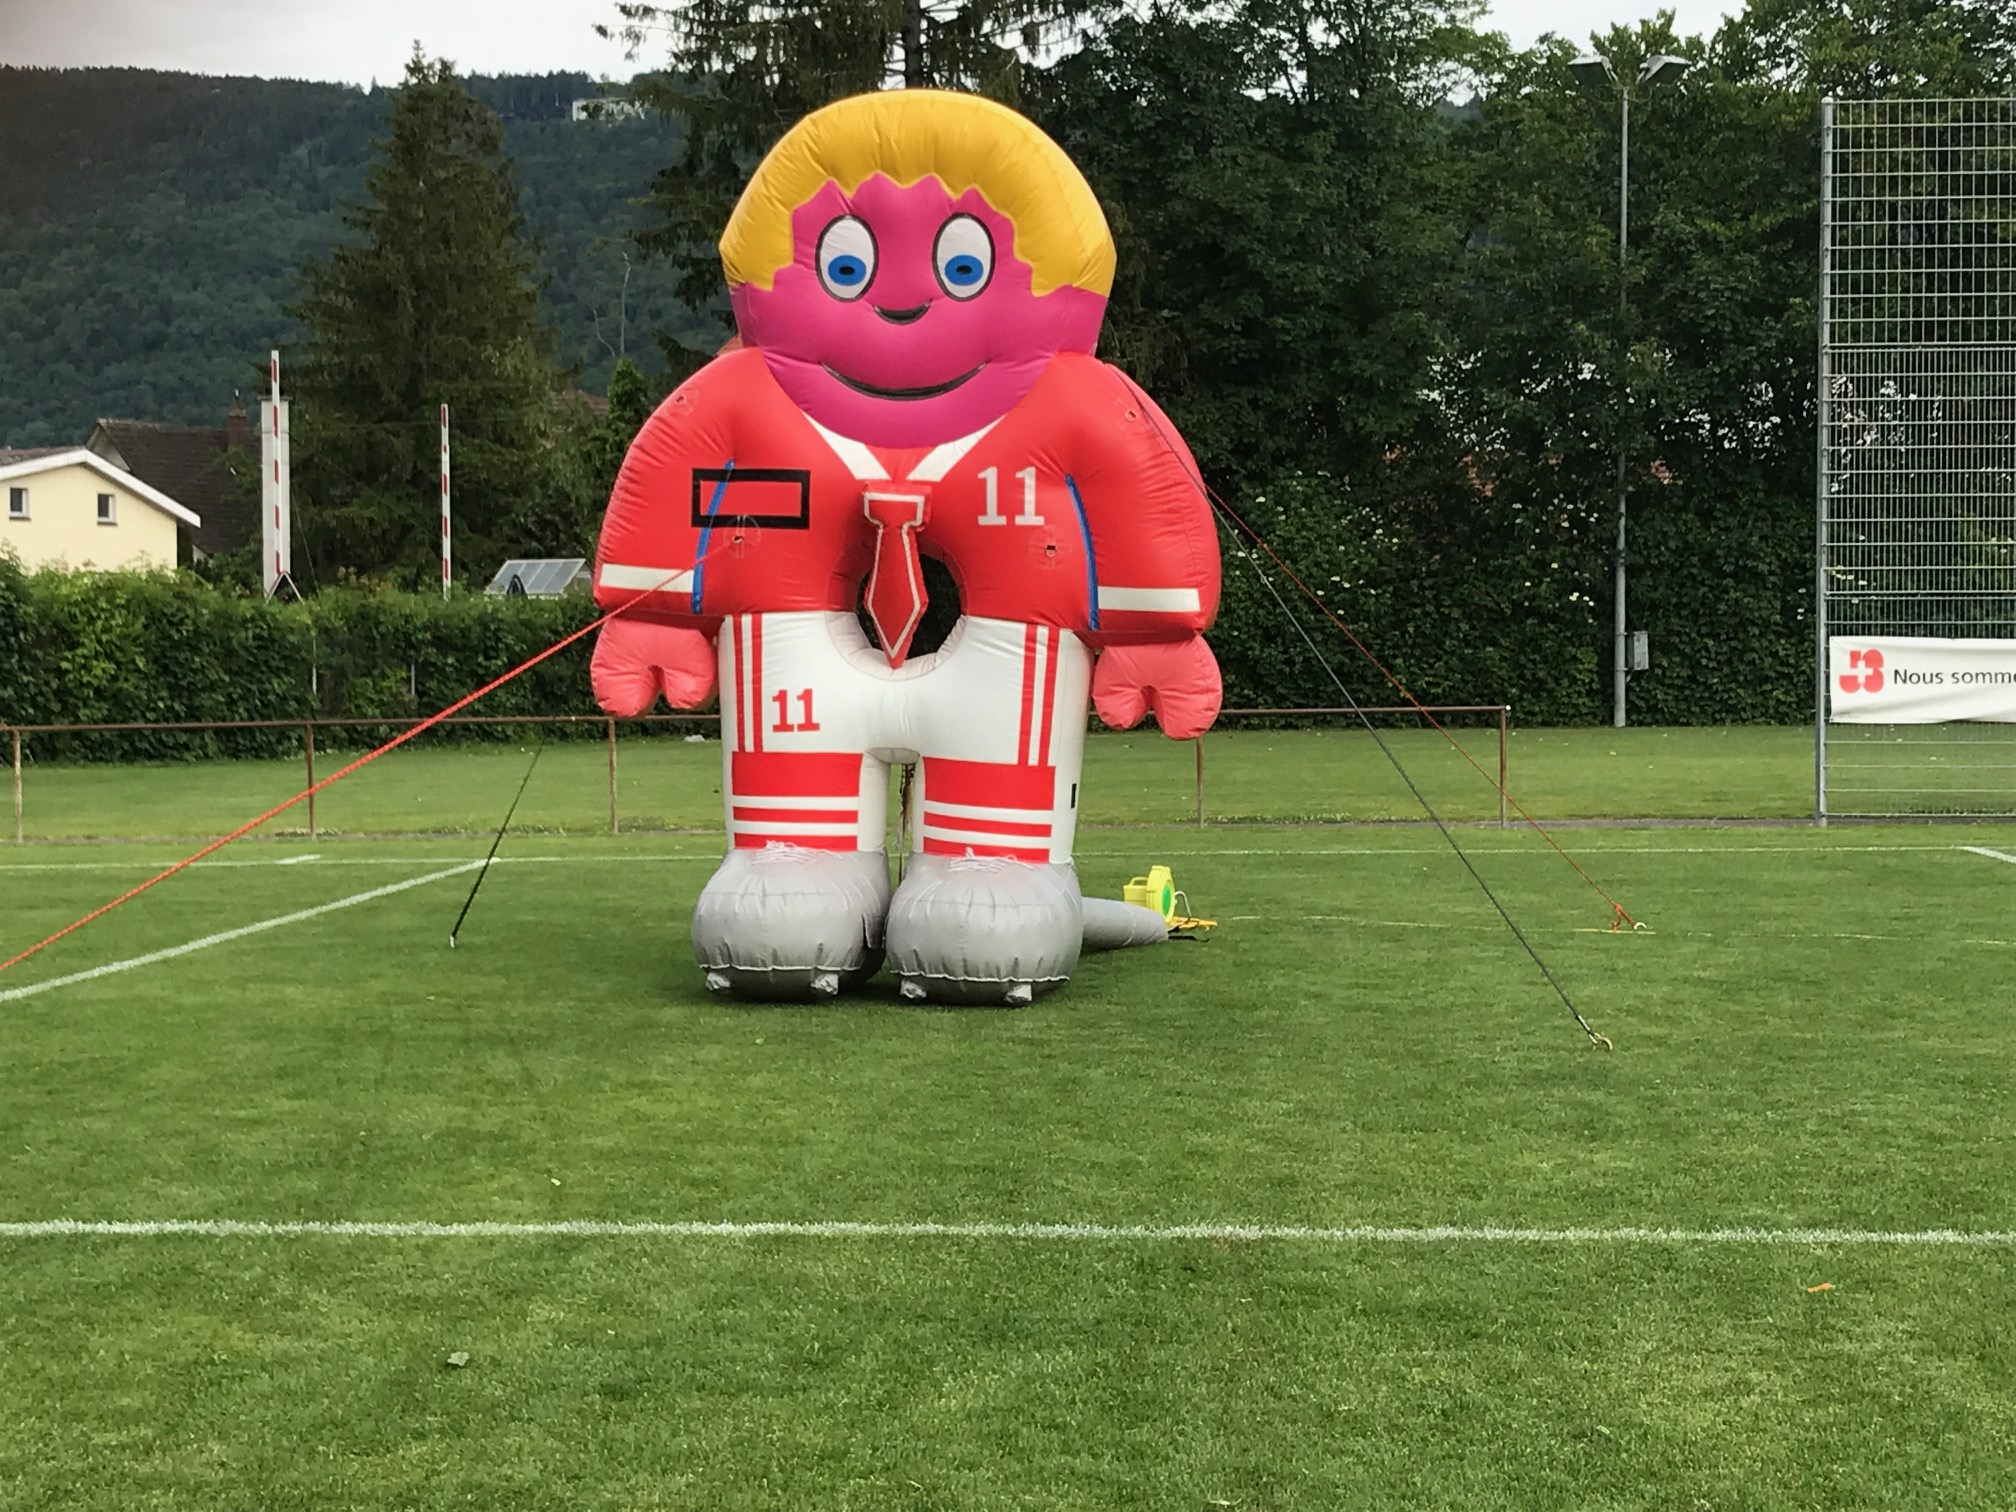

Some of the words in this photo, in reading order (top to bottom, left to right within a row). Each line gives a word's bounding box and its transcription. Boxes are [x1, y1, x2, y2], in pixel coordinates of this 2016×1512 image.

[977, 466, 1045, 526] 11
[1893, 668, 1944, 685] Nous
[1950, 671, 2016, 685] somm
[772, 688, 820, 733] 11
